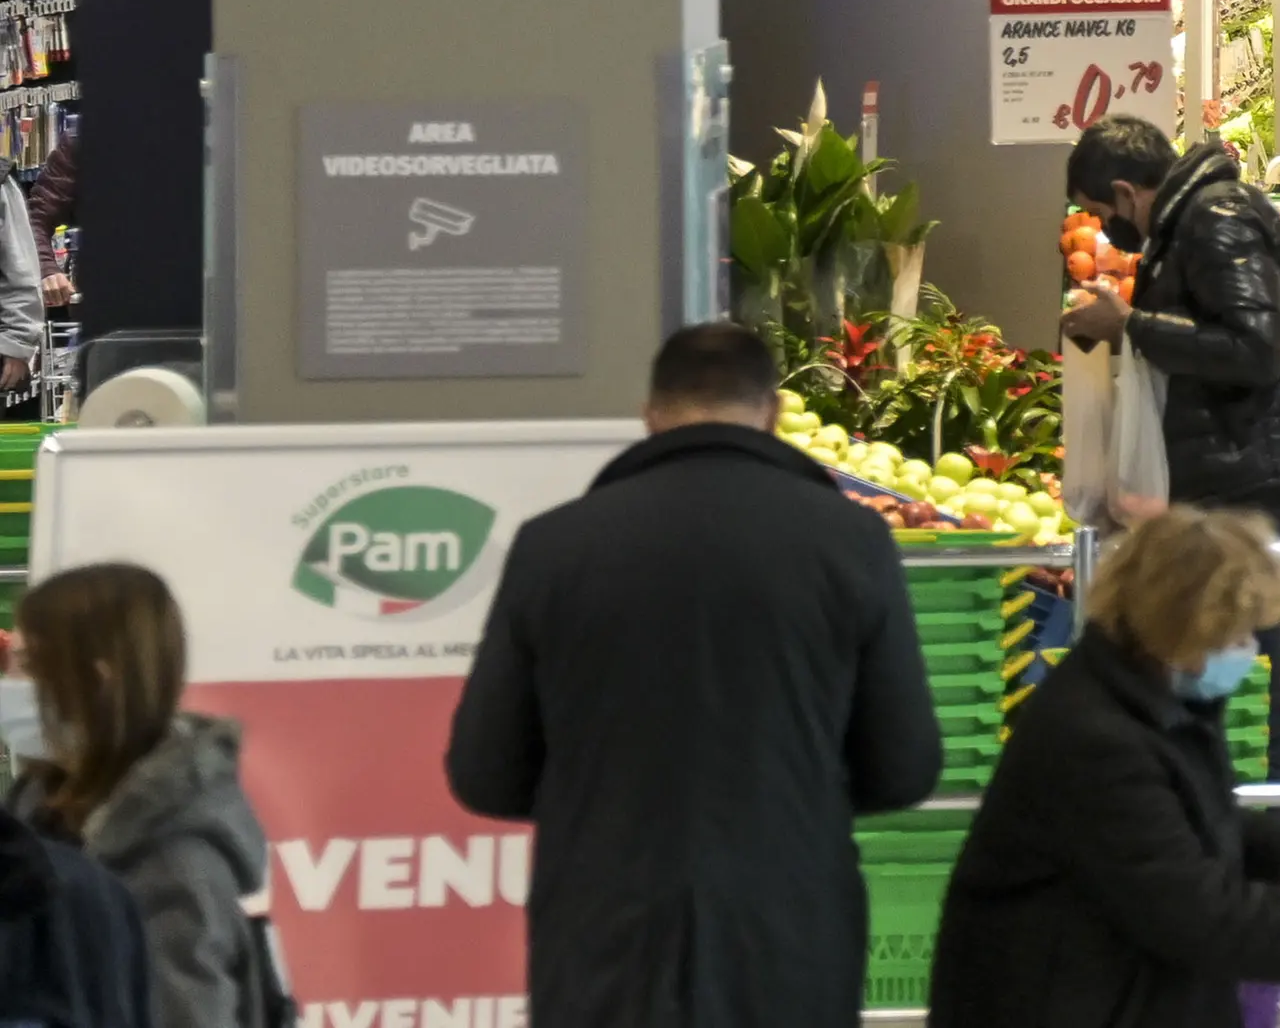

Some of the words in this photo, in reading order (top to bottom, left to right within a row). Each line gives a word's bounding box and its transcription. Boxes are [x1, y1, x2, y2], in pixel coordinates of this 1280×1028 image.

[1002, 21, 1060, 38] ARANCE
[1065, 20, 1112, 38] NAVEL
[1115, 20, 1136, 35] KG
[1003, 46, 1030, 67] 2,5
[408, 123, 475, 144] AREA
[322, 153, 559, 177] VIDEOSORVEGLIATA
[328, 523, 460, 573] Pam
[274, 646, 298, 662] LA
[304, 645, 345, 660] VITA
[352, 644, 409, 659] SPESA
[416, 643, 438, 658] AL
